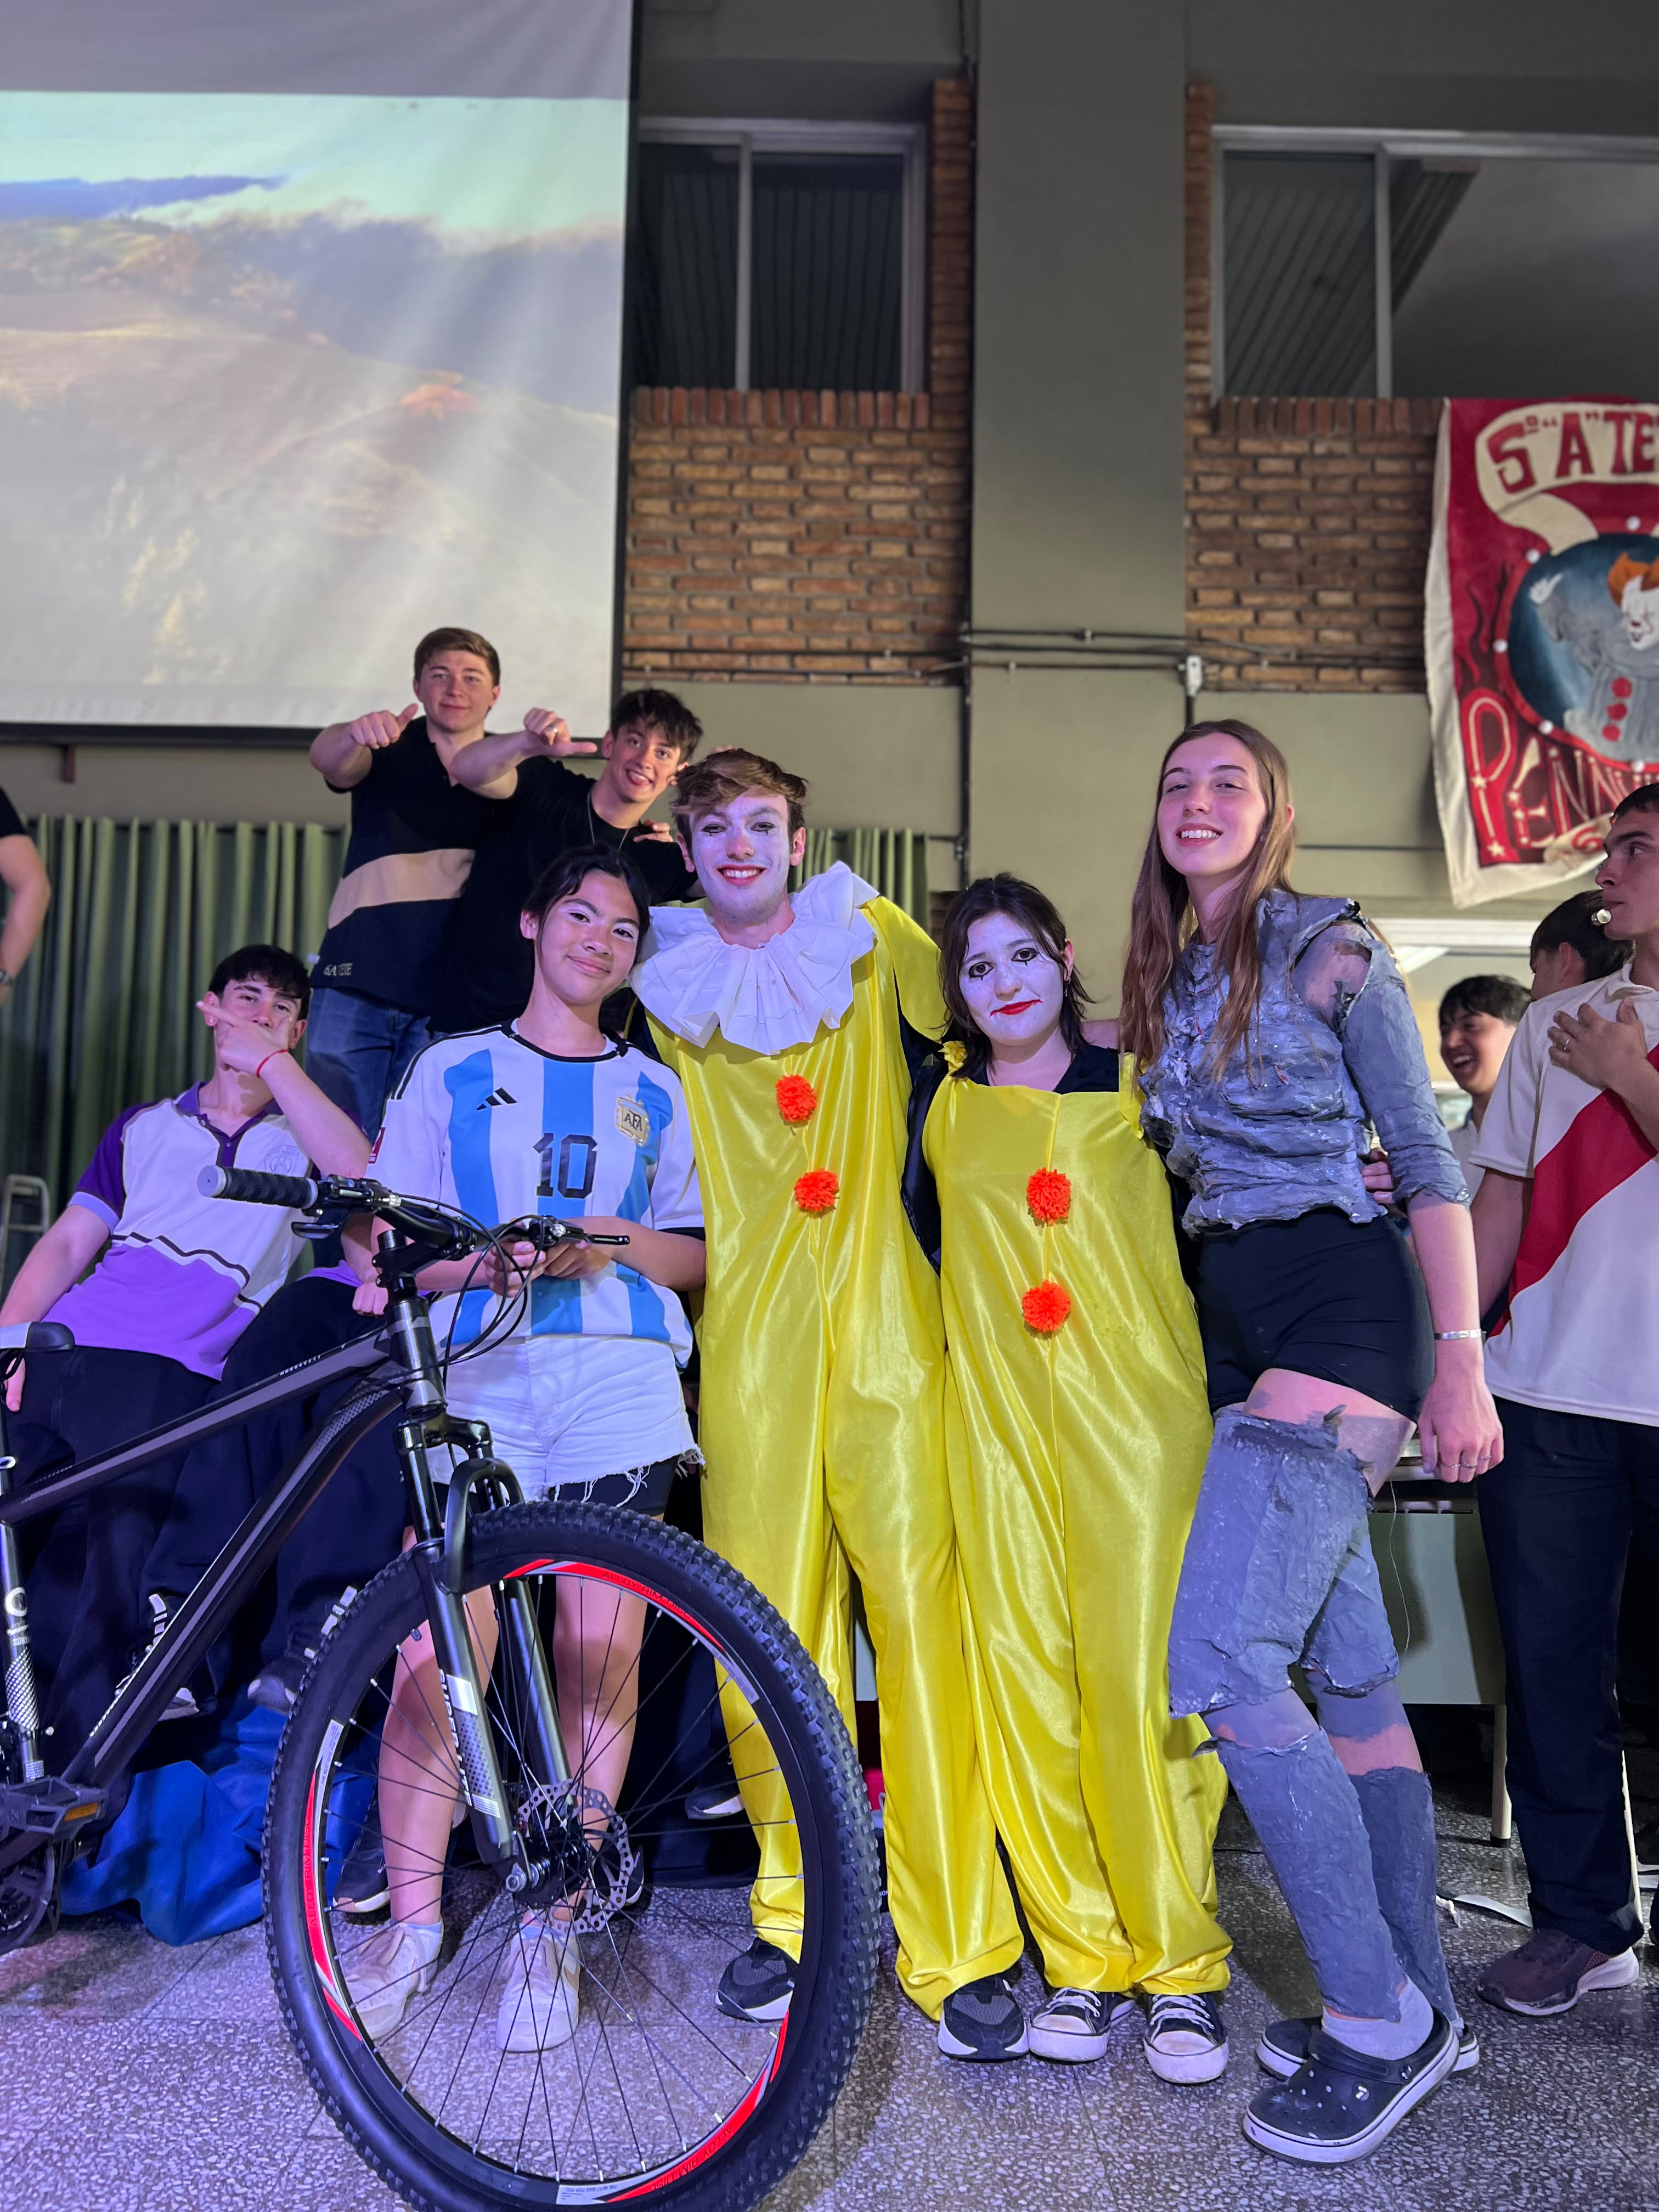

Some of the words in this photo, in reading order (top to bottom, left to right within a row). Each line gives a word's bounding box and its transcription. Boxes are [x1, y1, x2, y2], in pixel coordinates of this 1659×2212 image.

[1603, 410, 1659, 475] TE
[624, 1109, 643, 1132] AFA
[532, 1132, 599, 1199] 10
[602, 1571, 638, 1588] ALLOY
[641, 1585, 664, 1601] RIM
[303, 1853, 313, 1879] RIM
[304, 1888, 317, 1928] ALLOY
[703, 2124, 732, 2160] ALLOY
